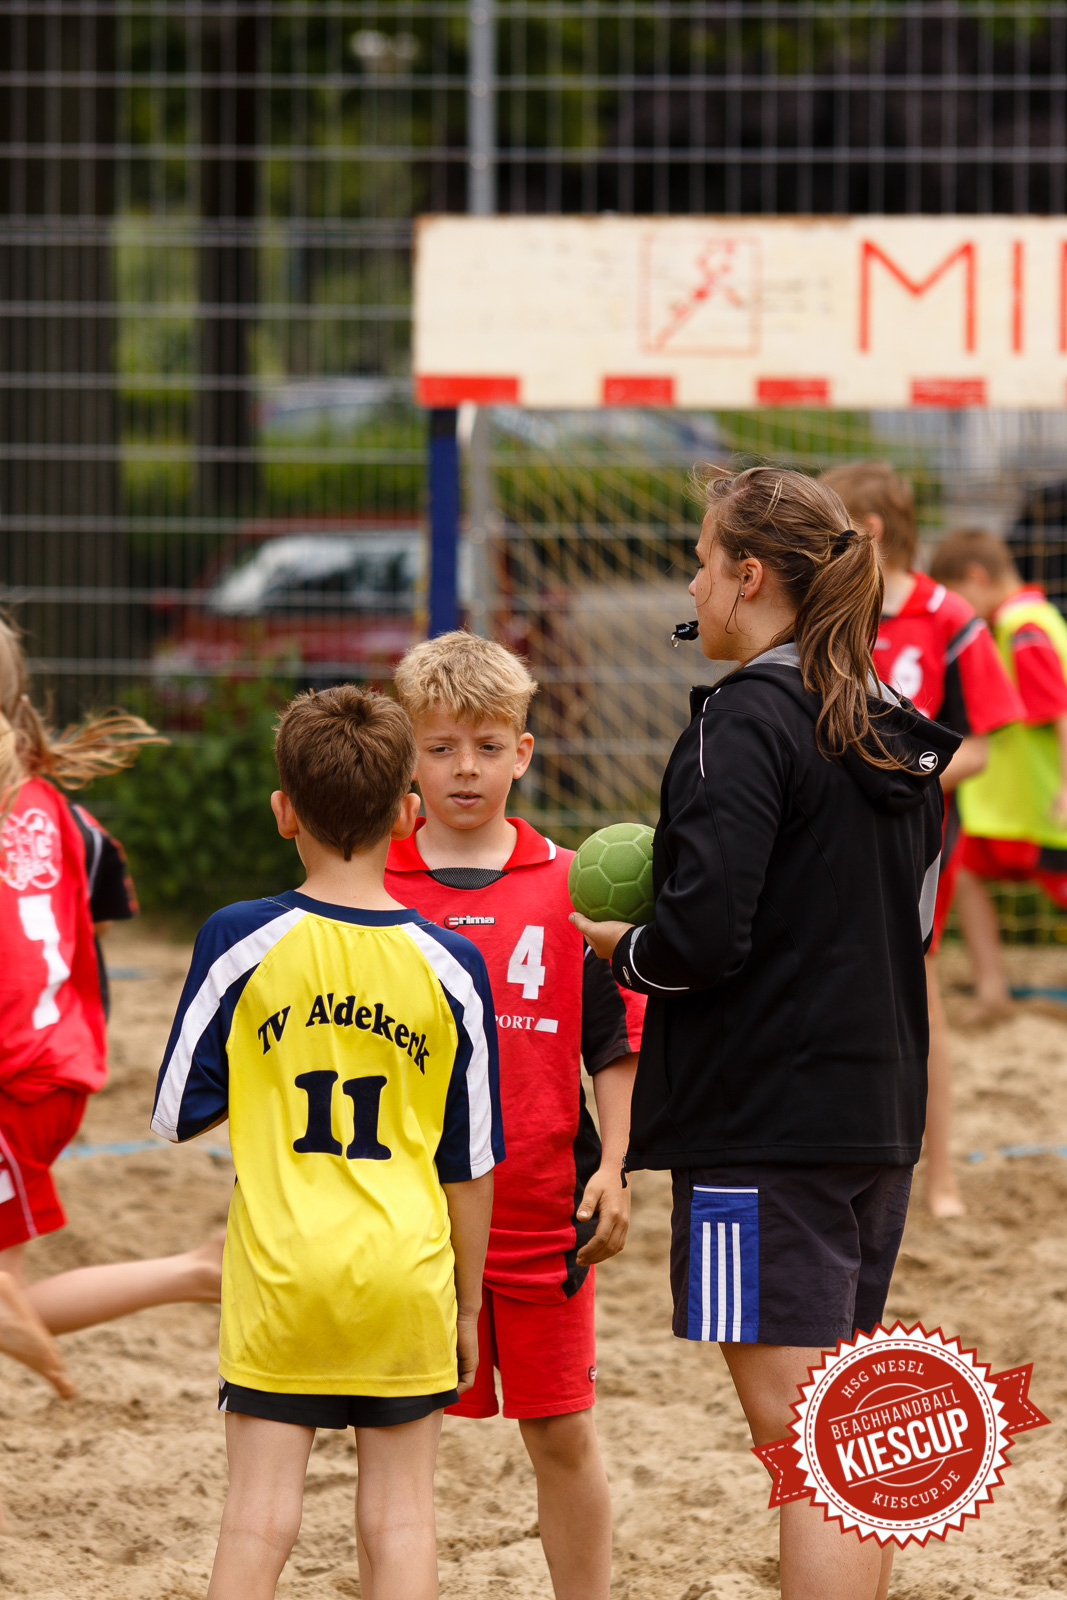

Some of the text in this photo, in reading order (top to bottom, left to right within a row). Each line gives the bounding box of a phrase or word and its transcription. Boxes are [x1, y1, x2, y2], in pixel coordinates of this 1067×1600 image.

[858, 239, 1067, 354] MI
[890, 645, 922, 700] 6
[507, 925, 546, 1000] 4
[257, 993, 430, 1075] TV Aldekerk
[293, 1070, 392, 1160] 11
